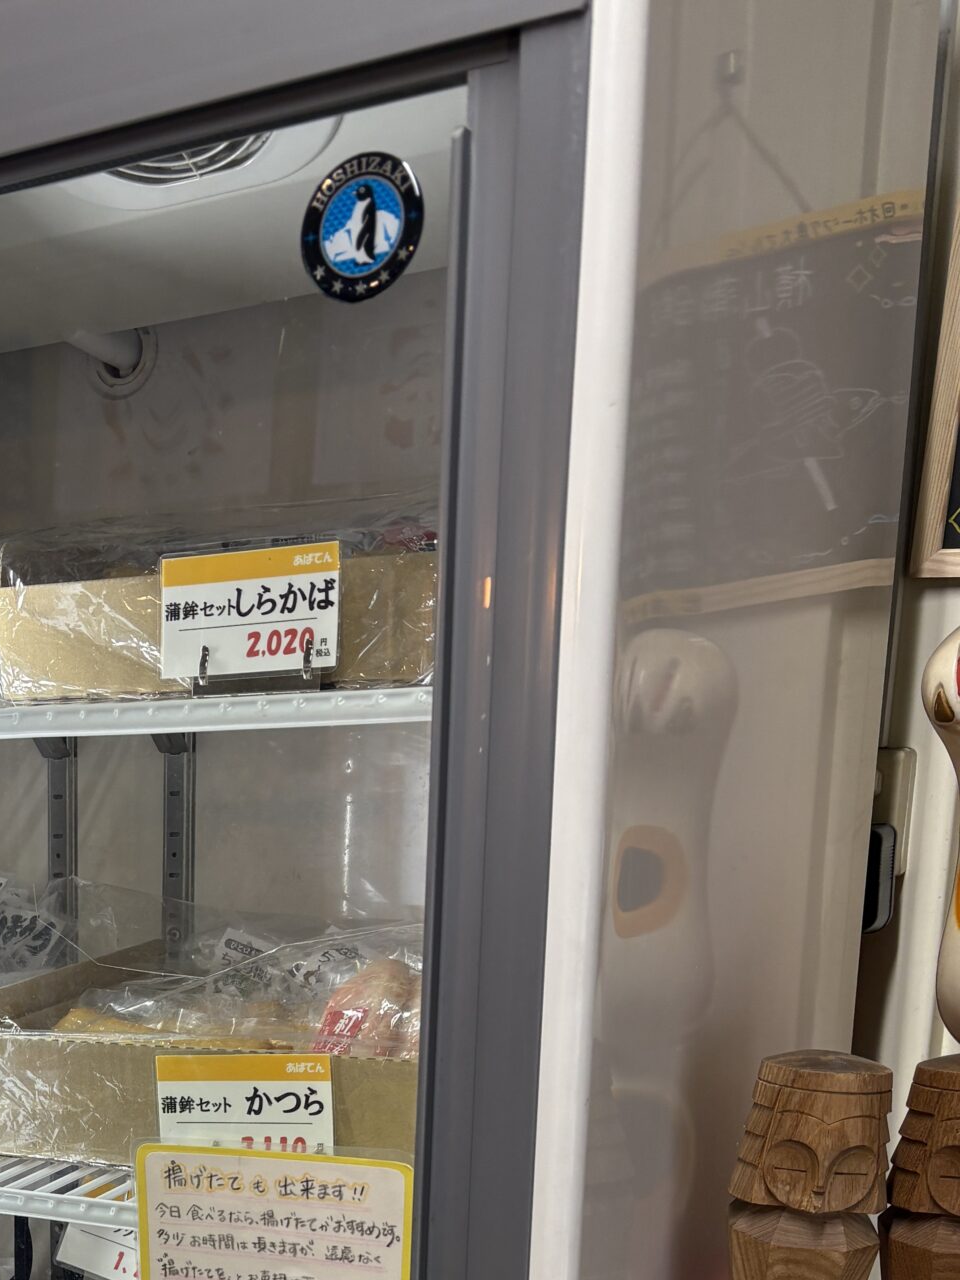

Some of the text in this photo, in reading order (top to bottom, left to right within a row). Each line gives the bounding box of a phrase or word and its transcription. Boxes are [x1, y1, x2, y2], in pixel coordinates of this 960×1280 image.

[312, 156, 411, 212] HOSHIZAKI
[292, 551, 332, 567] あばてん
[165, 578, 336, 622] 蒲鉾セット しらかば
[246, 627, 315, 658] 2,020
[286, 1062, 325, 1073] あばてん
[161, 1087, 324, 1116] 蒲鉾セット かつら
